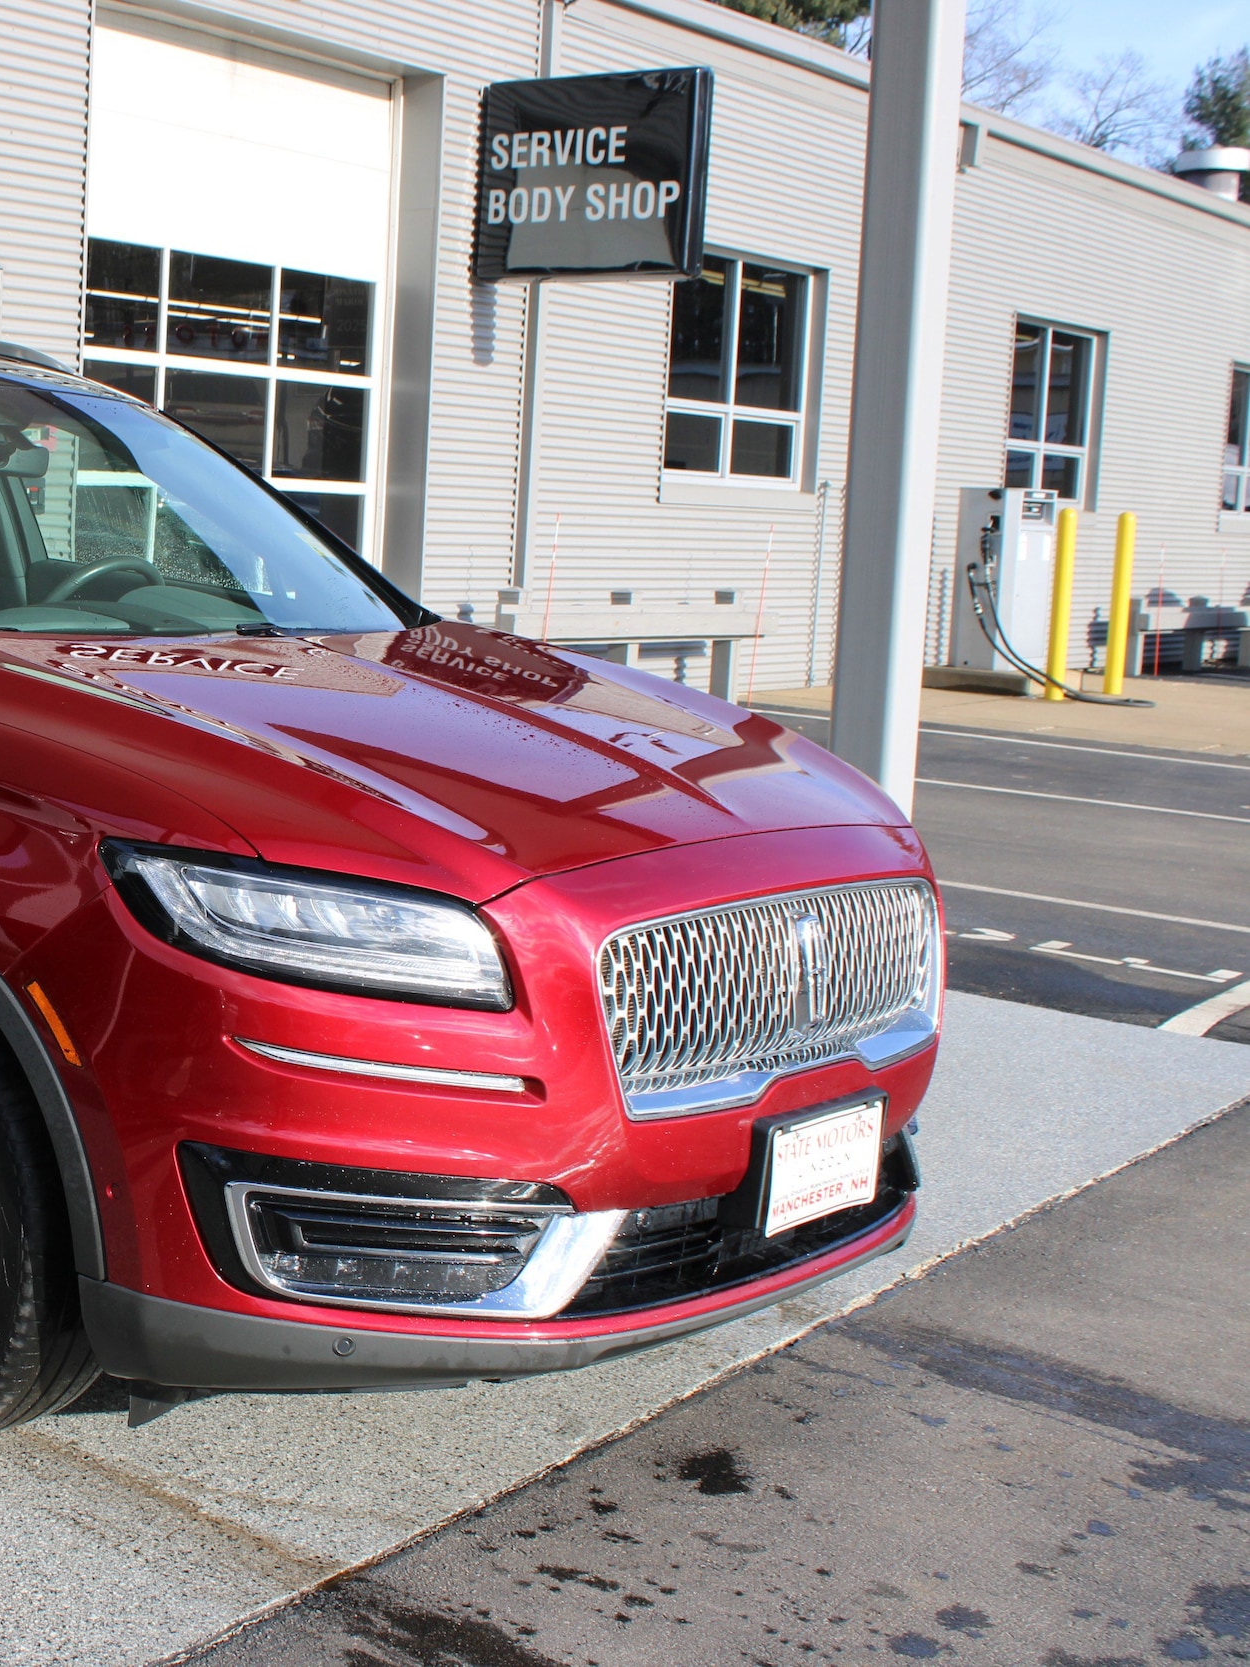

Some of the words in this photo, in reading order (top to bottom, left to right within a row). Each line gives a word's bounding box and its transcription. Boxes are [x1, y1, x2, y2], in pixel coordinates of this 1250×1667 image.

[490, 125, 628, 170] SERVICE
[487, 185, 575, 225] BODY
[585, 180, 680, 221] SHOP
[777, 1135, 812, 1167] STATE
[817, 1118, 874, 1150] MOTORS
[850, 1176, 868, 1192] NH
